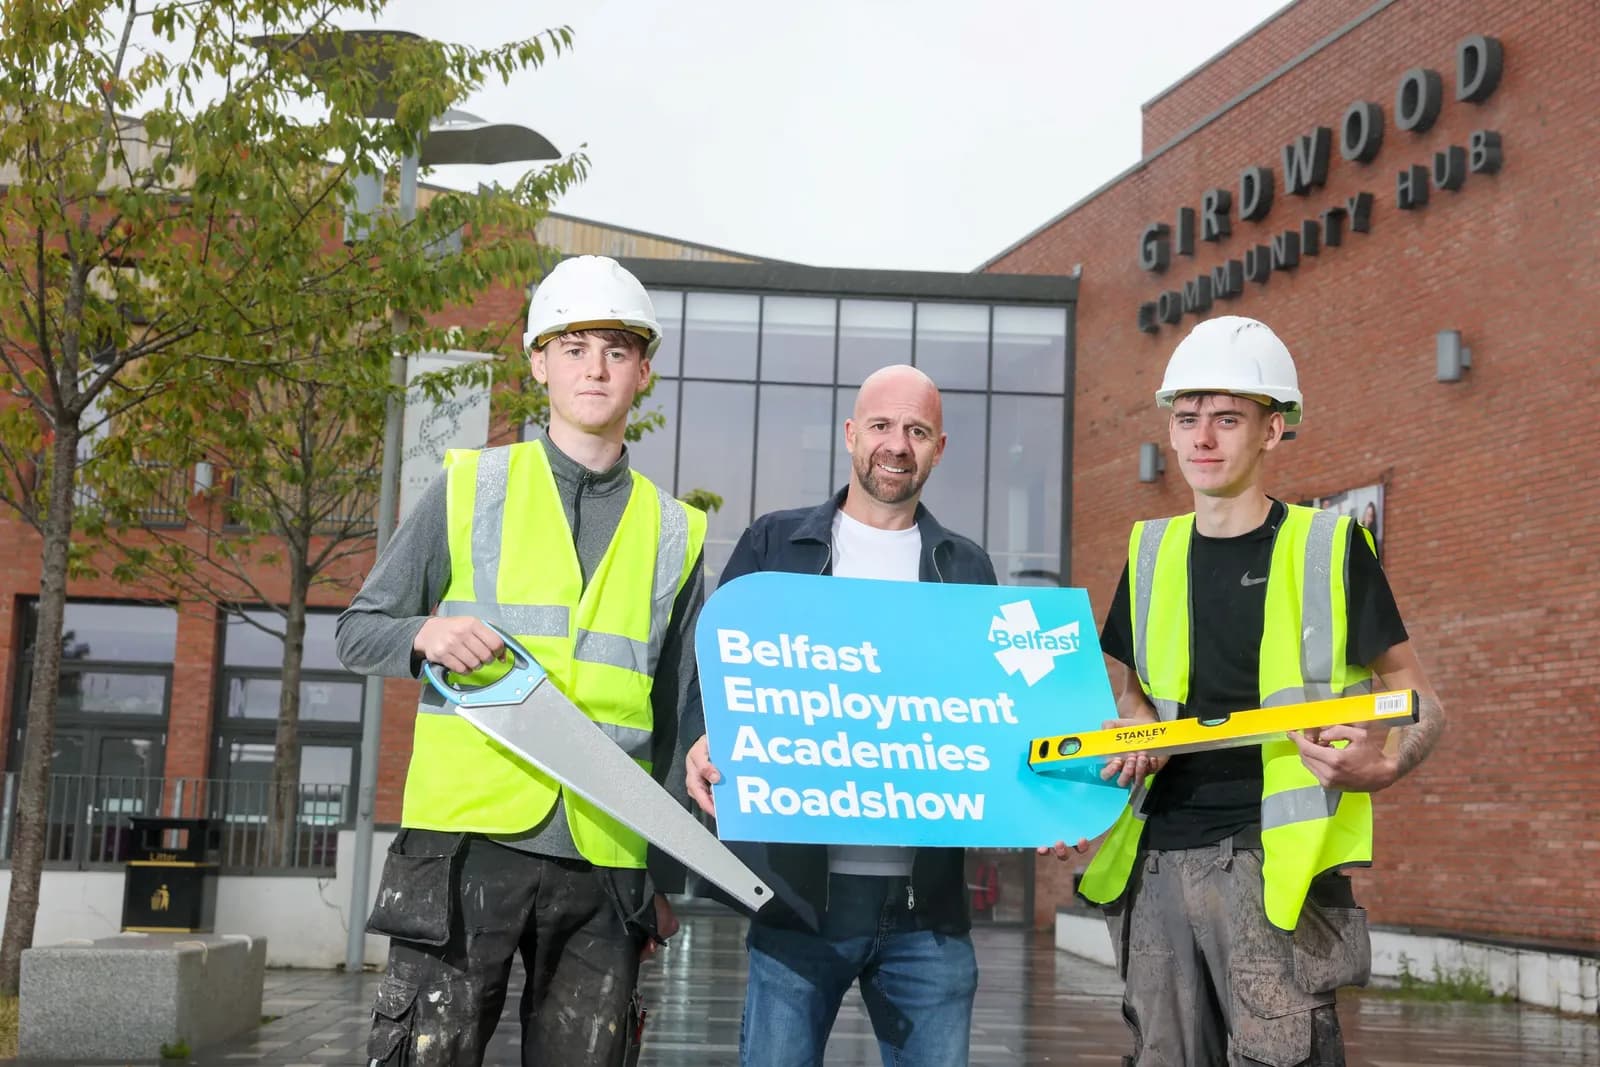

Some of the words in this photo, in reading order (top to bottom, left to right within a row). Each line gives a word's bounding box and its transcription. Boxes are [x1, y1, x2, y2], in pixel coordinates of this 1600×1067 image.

[1139, 34, 1504, 273] GIRDWOOD
[1138, 191, 1374, 334] COMMUNITY
[1396, 129, 1503, 211] HUB
[718, 629, 881, 673] Belfast
[992, 629, 1080, 651] Belfast
[724, 676, 1018, 730] Employment
[731, 726, 990, 772] Academies
[1115, 727, 1168, 741] STANLEY
[737, 776, 984, 820] Roadshow
